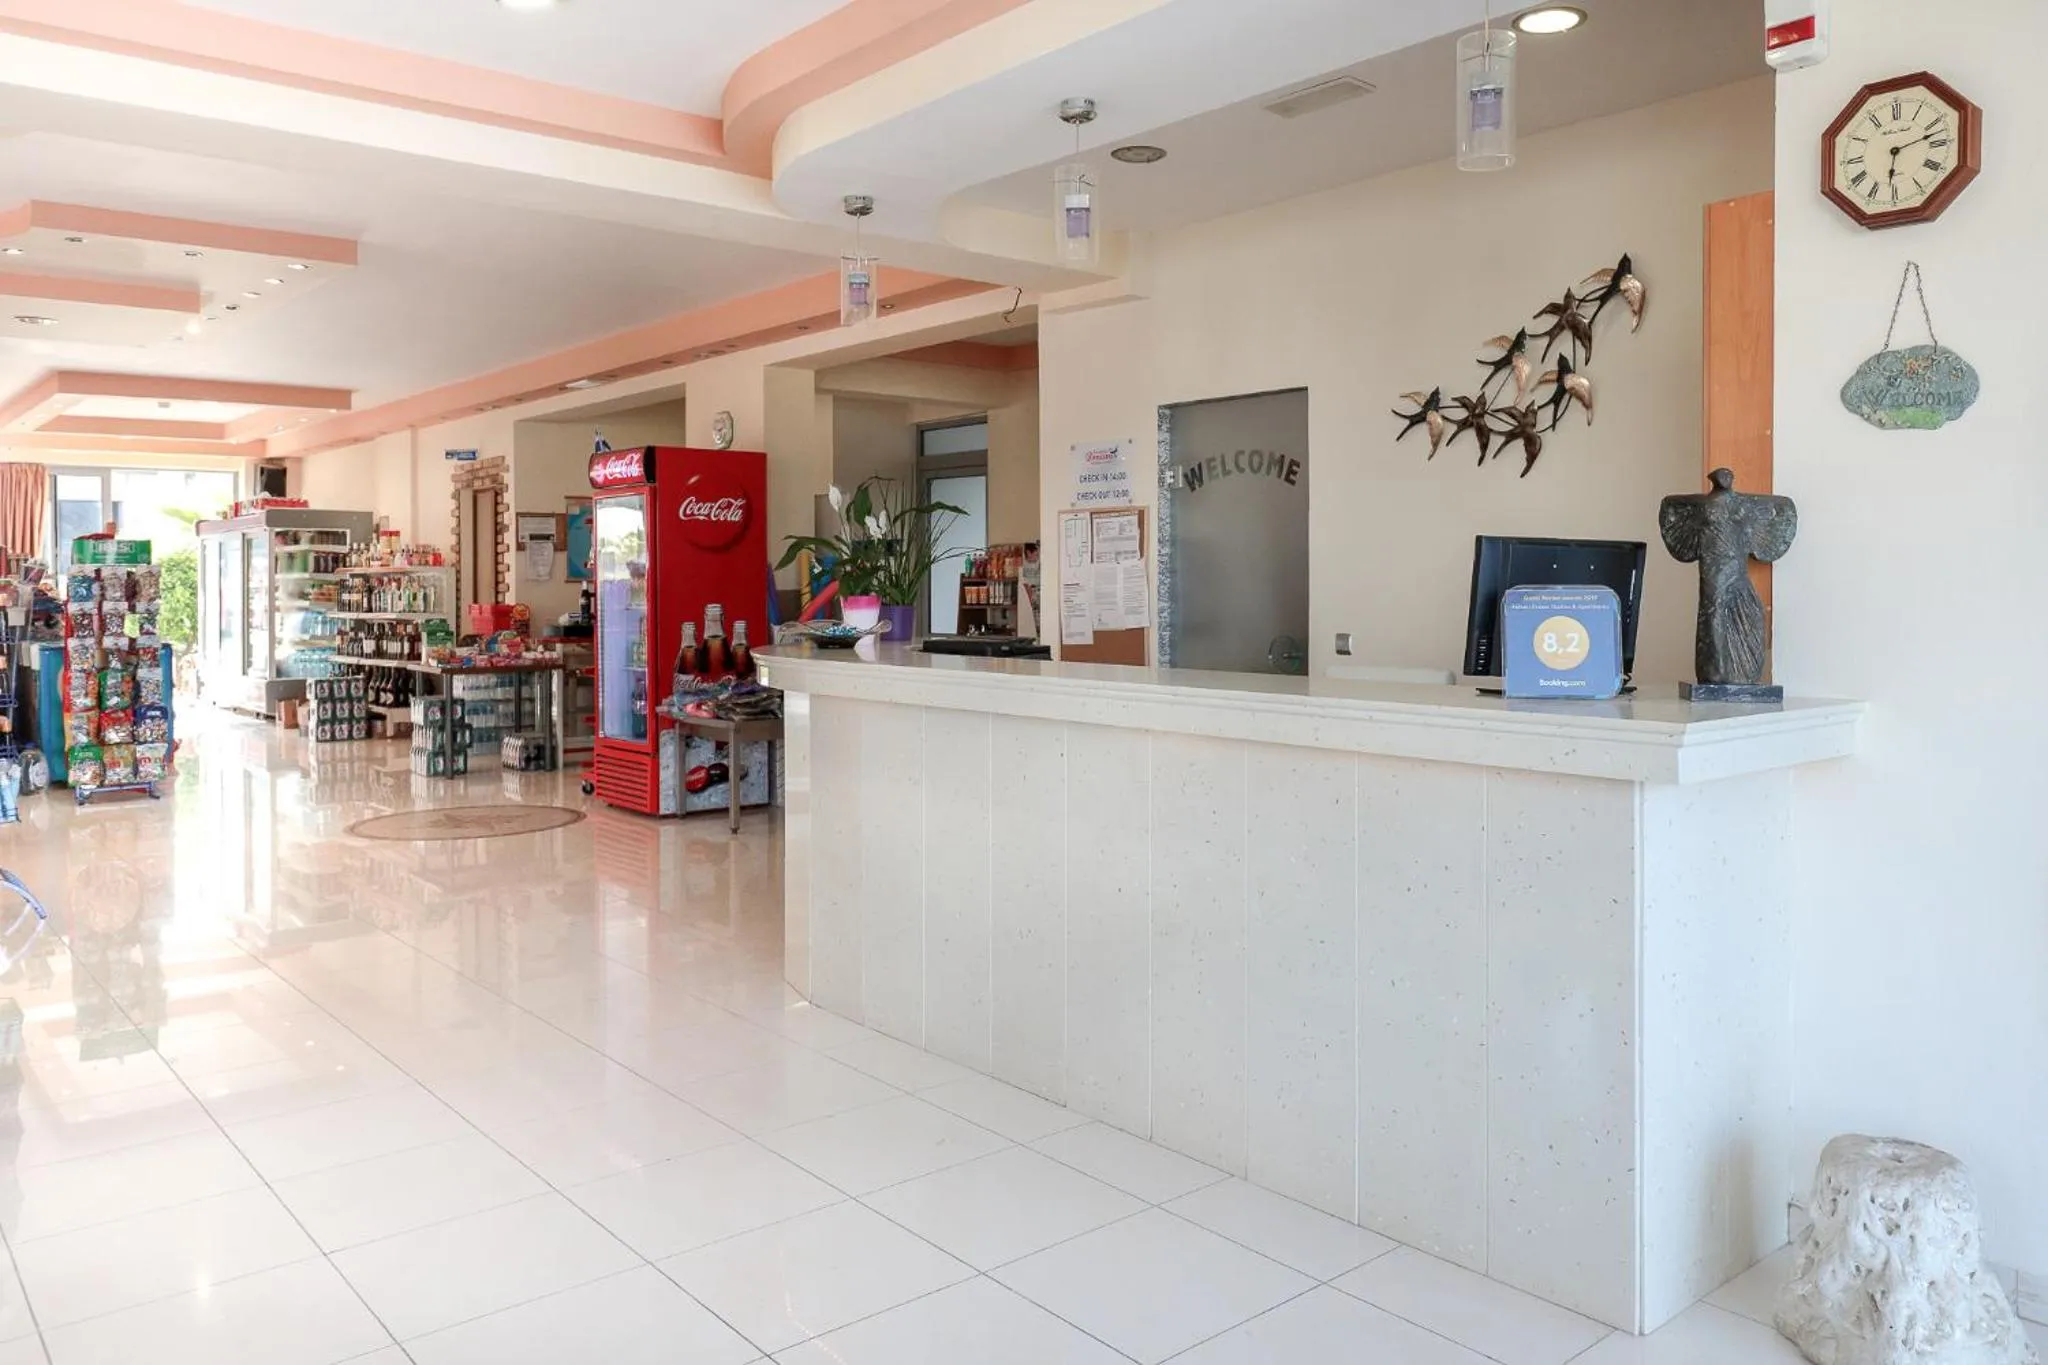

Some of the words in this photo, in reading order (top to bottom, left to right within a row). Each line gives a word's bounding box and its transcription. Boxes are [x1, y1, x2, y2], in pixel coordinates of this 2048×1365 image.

[1863, 388, 1964, 413] WELCOME
[1079, 473, 1100, 483] CHECK
[1183, 449, 1301, 493] WELCOME
[1076, 491, 1097, 501] CHECK
[679, 496, 747, 522] Coca-Cola
[1543, 632, 1581, 655] 8,2
[1539, 678, 1586, 688] Booking.com
